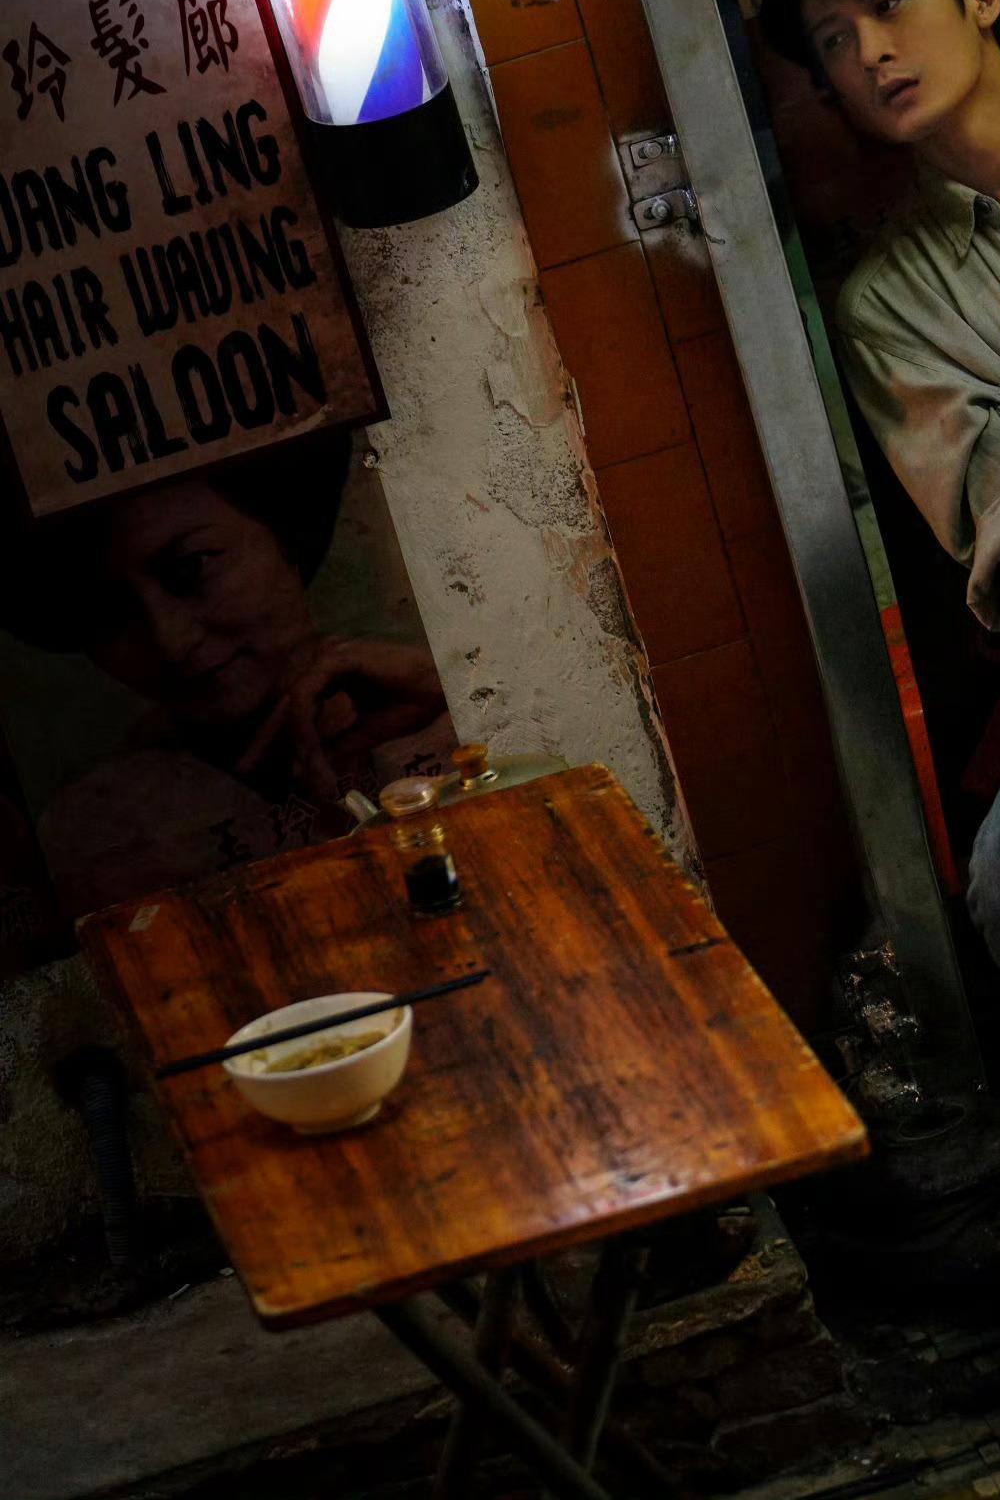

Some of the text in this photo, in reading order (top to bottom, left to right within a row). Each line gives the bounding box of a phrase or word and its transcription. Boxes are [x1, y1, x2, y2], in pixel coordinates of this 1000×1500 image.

[146, 99, 281, 216] LING
[0, 266, 118, 376] HAIR
[46, 312, 328, 483] SALOON
